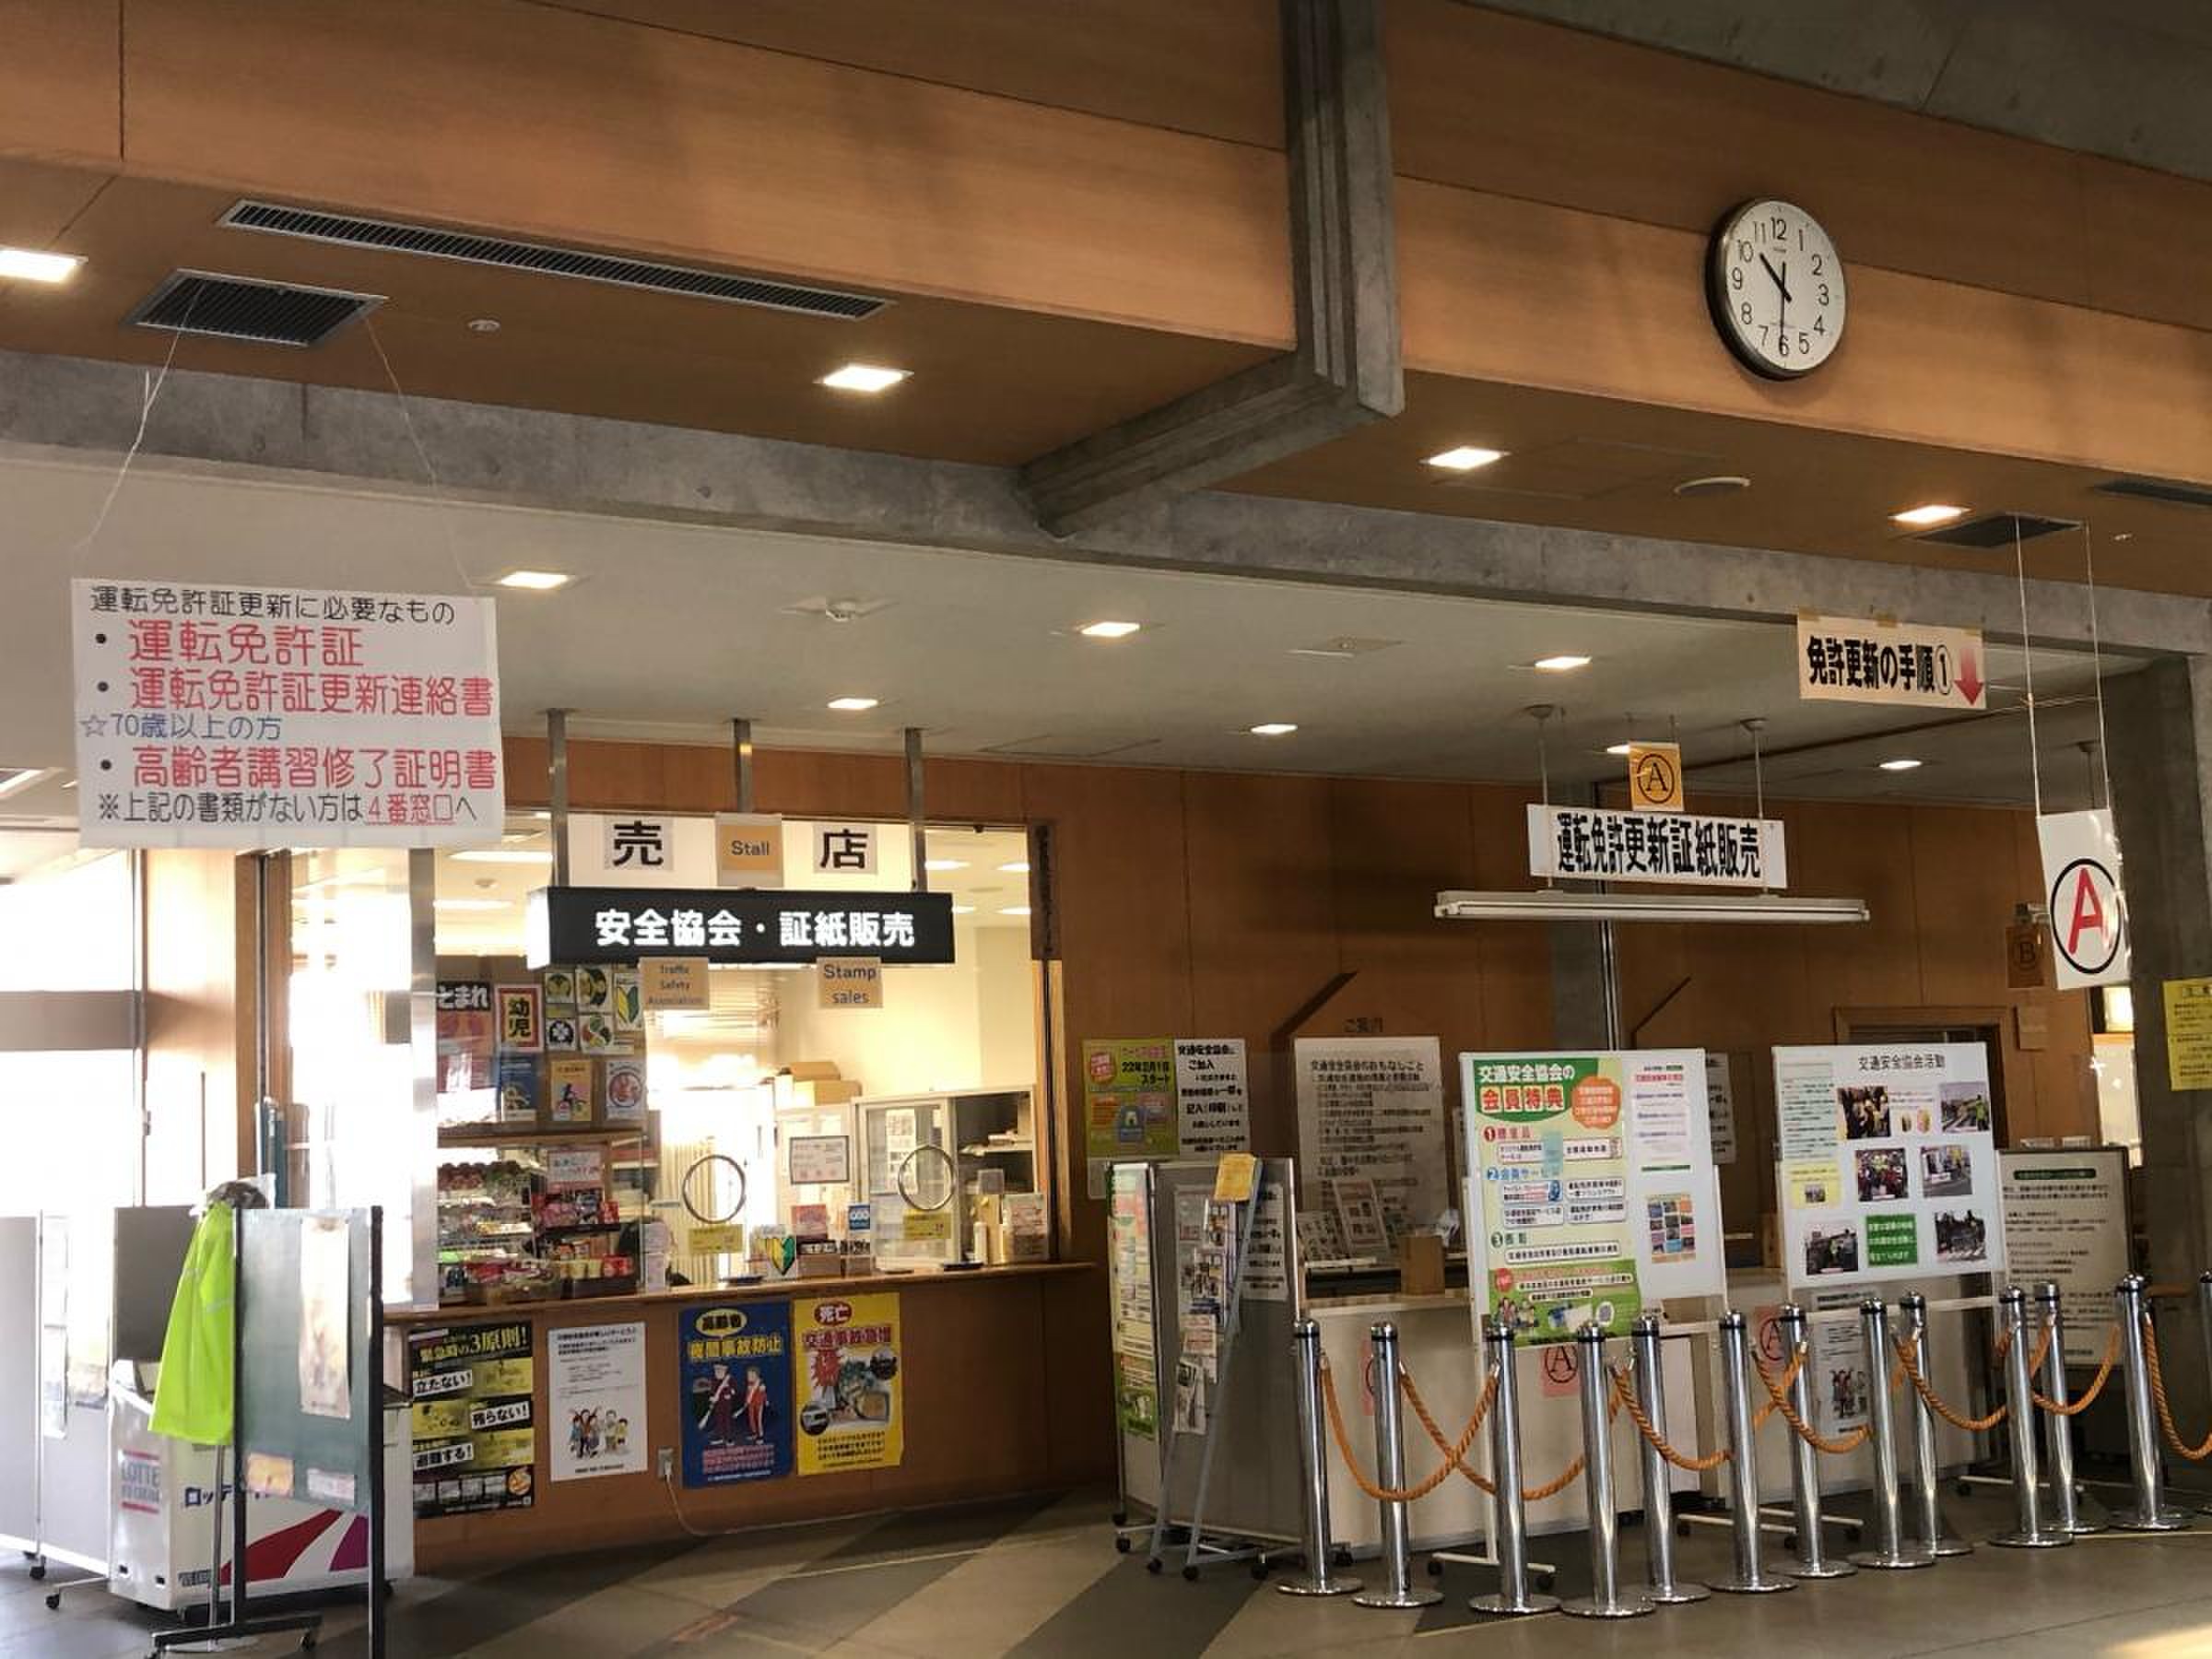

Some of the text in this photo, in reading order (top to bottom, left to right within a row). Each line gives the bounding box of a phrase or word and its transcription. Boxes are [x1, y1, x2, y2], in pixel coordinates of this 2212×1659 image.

[1754, 221, 1766, 243] 11
[1771, 217, 1787, 241] 12
[1737, 240, 1754, 263] 10
[1811, 253, 1822, 276] 2
[1731, 267, 1743, 290] 9
[1818, 284, 1830, 306] 3
[1741, 302, 1752, 324] 8
[1759, 324, 1769, 346] 7
[1813, 315, 1826, 335] 4
[1779, 335, 1790, 357] 6
[1798, 333, 1810, 355] 5
[89, 585, 454, 626] 運転免許証更新に必要なもの
[127, 619, 364, 666] 運転免許証
[130, 667, 494, 716] 運転免許証更新連絡書
[133, 745, 497, 790] 高齢者講習修了証明書
[612, 820, 868, 869] 売 店
[731, 840, 770, 856] Stall
[1558, 812, 1760, 879] 運転免許更新証紙販売
[2067, 866, 2110, 953] A
[594, 908, 915, 947] 安全協会・証紙販売
[660, 964, 689, 974] Traffic
[823, 964, 877, 982] Stamp
[660, 980, 690, 991] Safety
[438, 986, 489, 1008] とまれ
[831, 991, 869, 1004] sales
[122, 1461, 160, 1487] LOTTE
